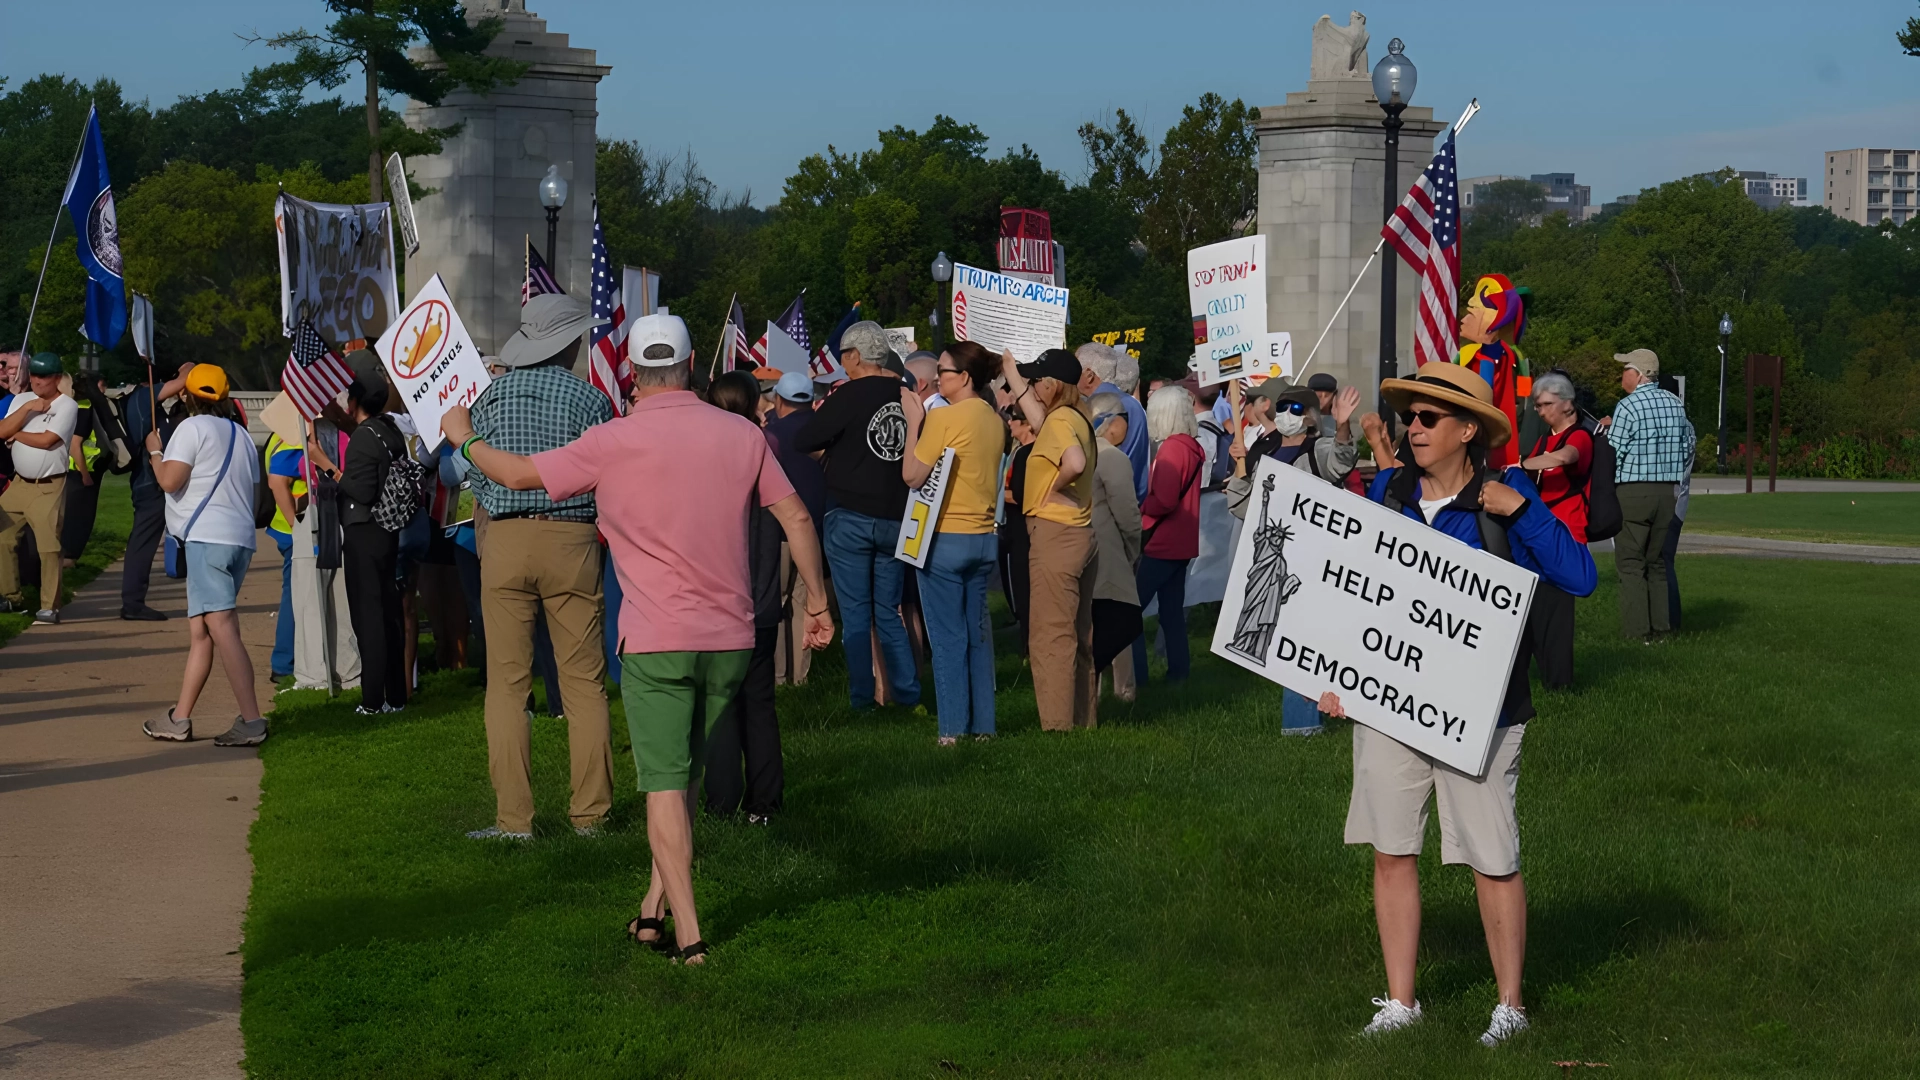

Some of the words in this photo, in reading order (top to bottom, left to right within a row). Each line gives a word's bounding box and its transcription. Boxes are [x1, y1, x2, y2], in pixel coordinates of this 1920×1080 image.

[1022, 283, 1067, 308] ARCH
[413, 382, 429, 403] NO
[438, 374, 459, 406] NO
[1291, 493, 1362, 540] KEEP
[1374, 531, 1522, 616] HONKING!
[1321, 559, 1395, 607] HELP
[1408, 599, 1482, 649] SAVE
[1362, 627, 1424, 673] OUR
[1276, 636, 1466, 743] DEMOCRACY!
